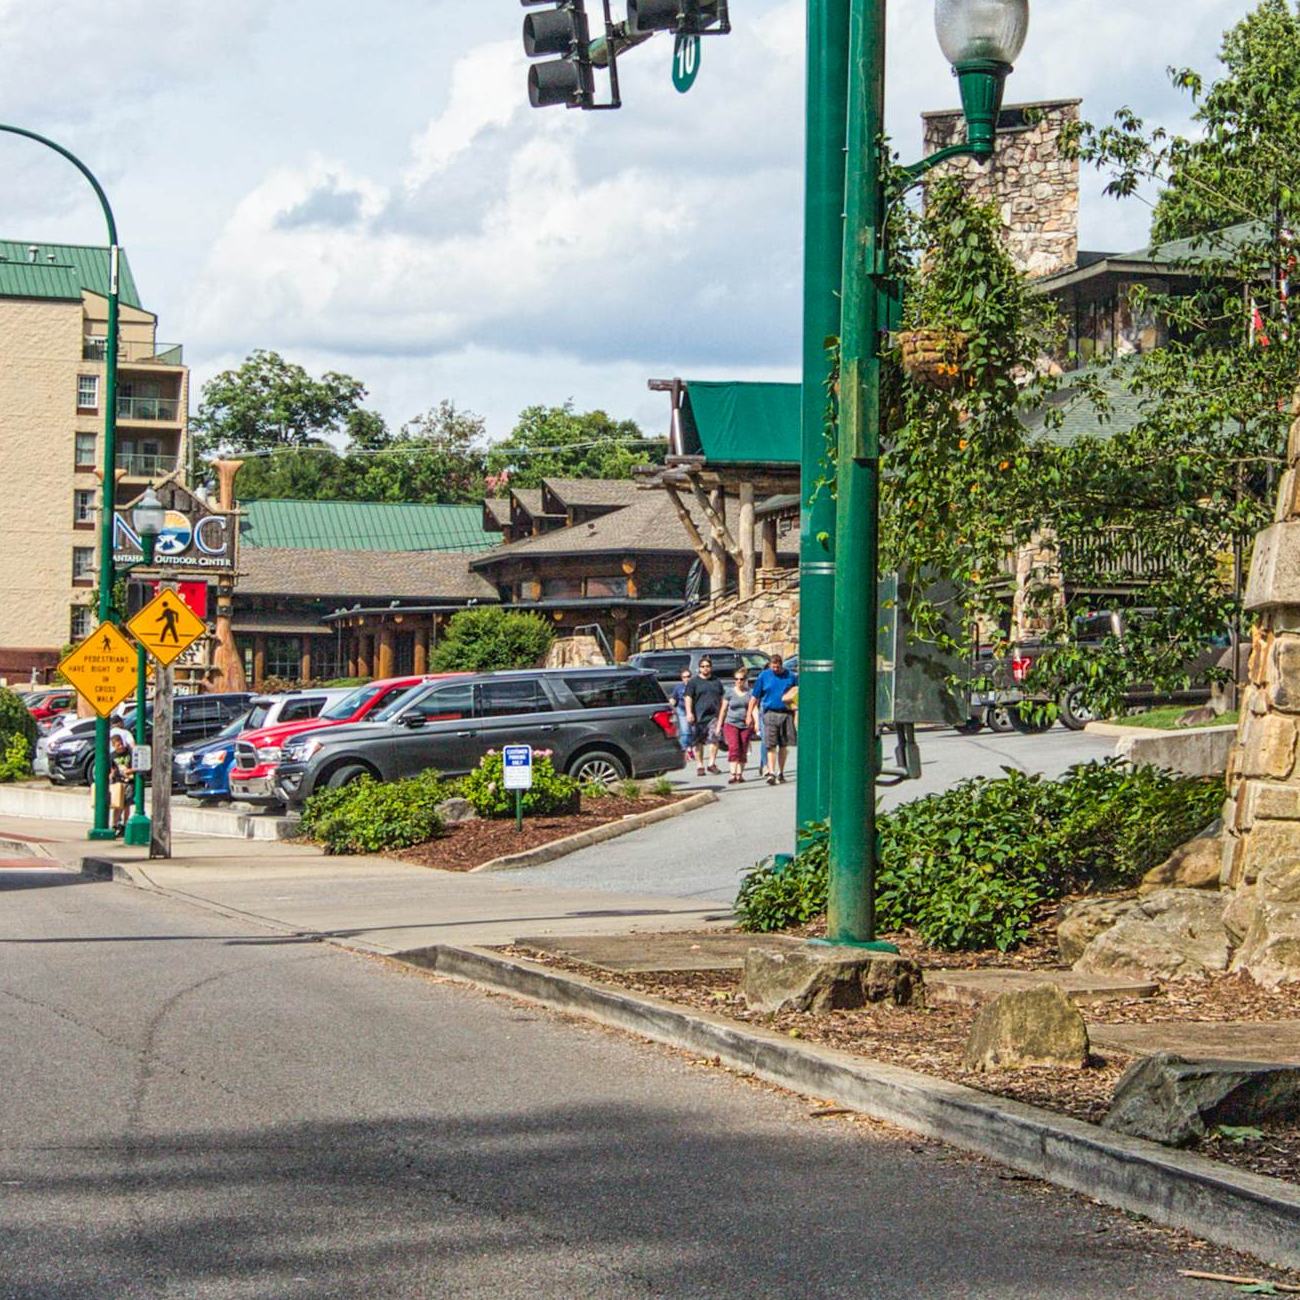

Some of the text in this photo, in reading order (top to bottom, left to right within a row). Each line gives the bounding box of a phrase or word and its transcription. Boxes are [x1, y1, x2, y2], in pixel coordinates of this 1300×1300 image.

[113, 554, 231, 567] ANTAHA OUTDOOR CENTER
[84, 655, 129, 663] PEDESTRIANS
[91, 665, 110, 673] RIGHT
[95, 685, 116, 693] CROSS
